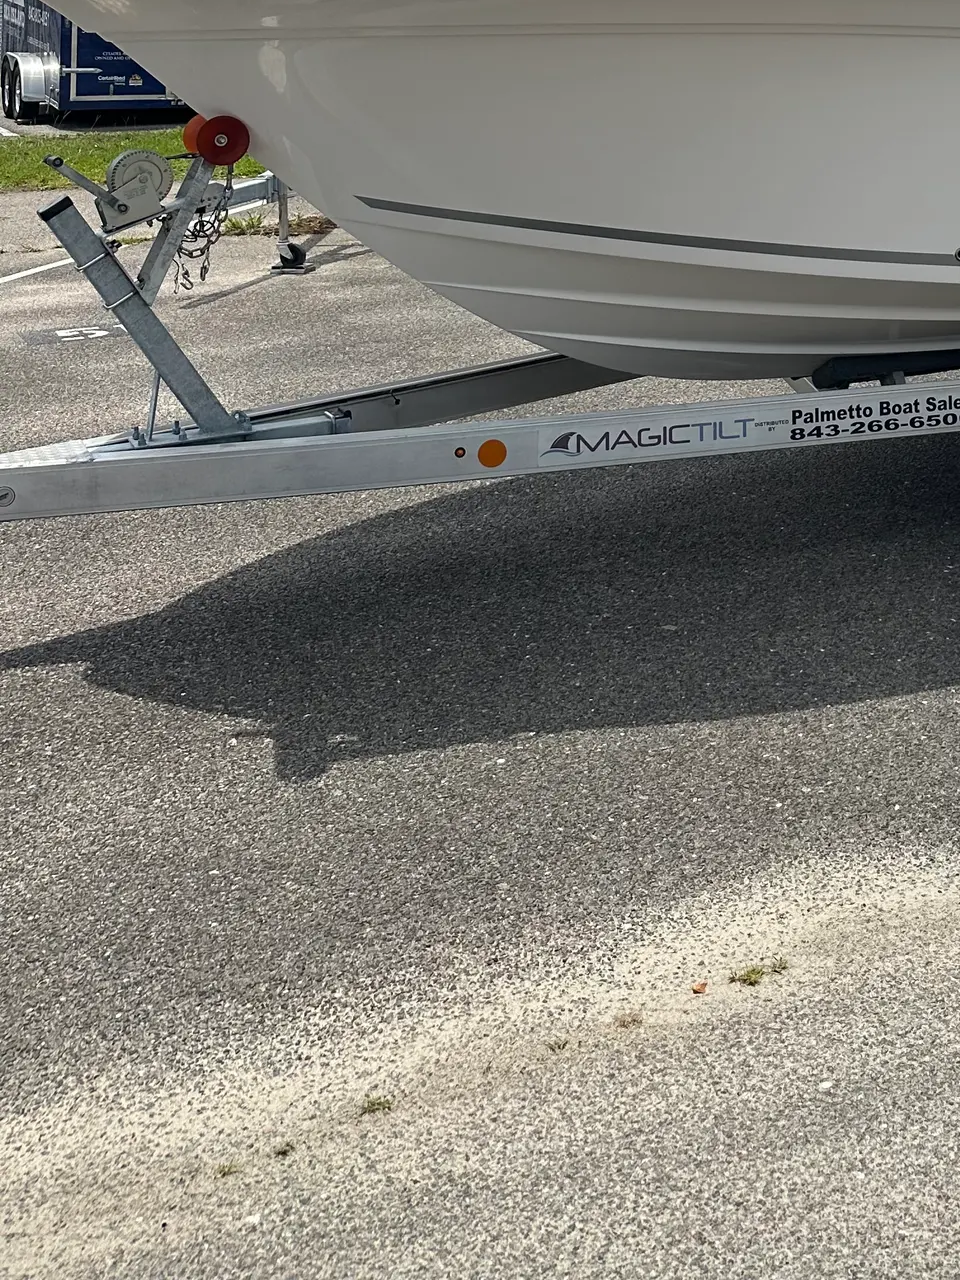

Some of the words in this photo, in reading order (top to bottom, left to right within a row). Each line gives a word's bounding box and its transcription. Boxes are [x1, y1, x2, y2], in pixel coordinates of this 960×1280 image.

[754, 419, 789, 427] DISTRIBUTED
[791, 403, 873, 425] Palmetto
[878, 399, 920, 416] Boat
[576, 418, 755, 453] MAGICTILT
